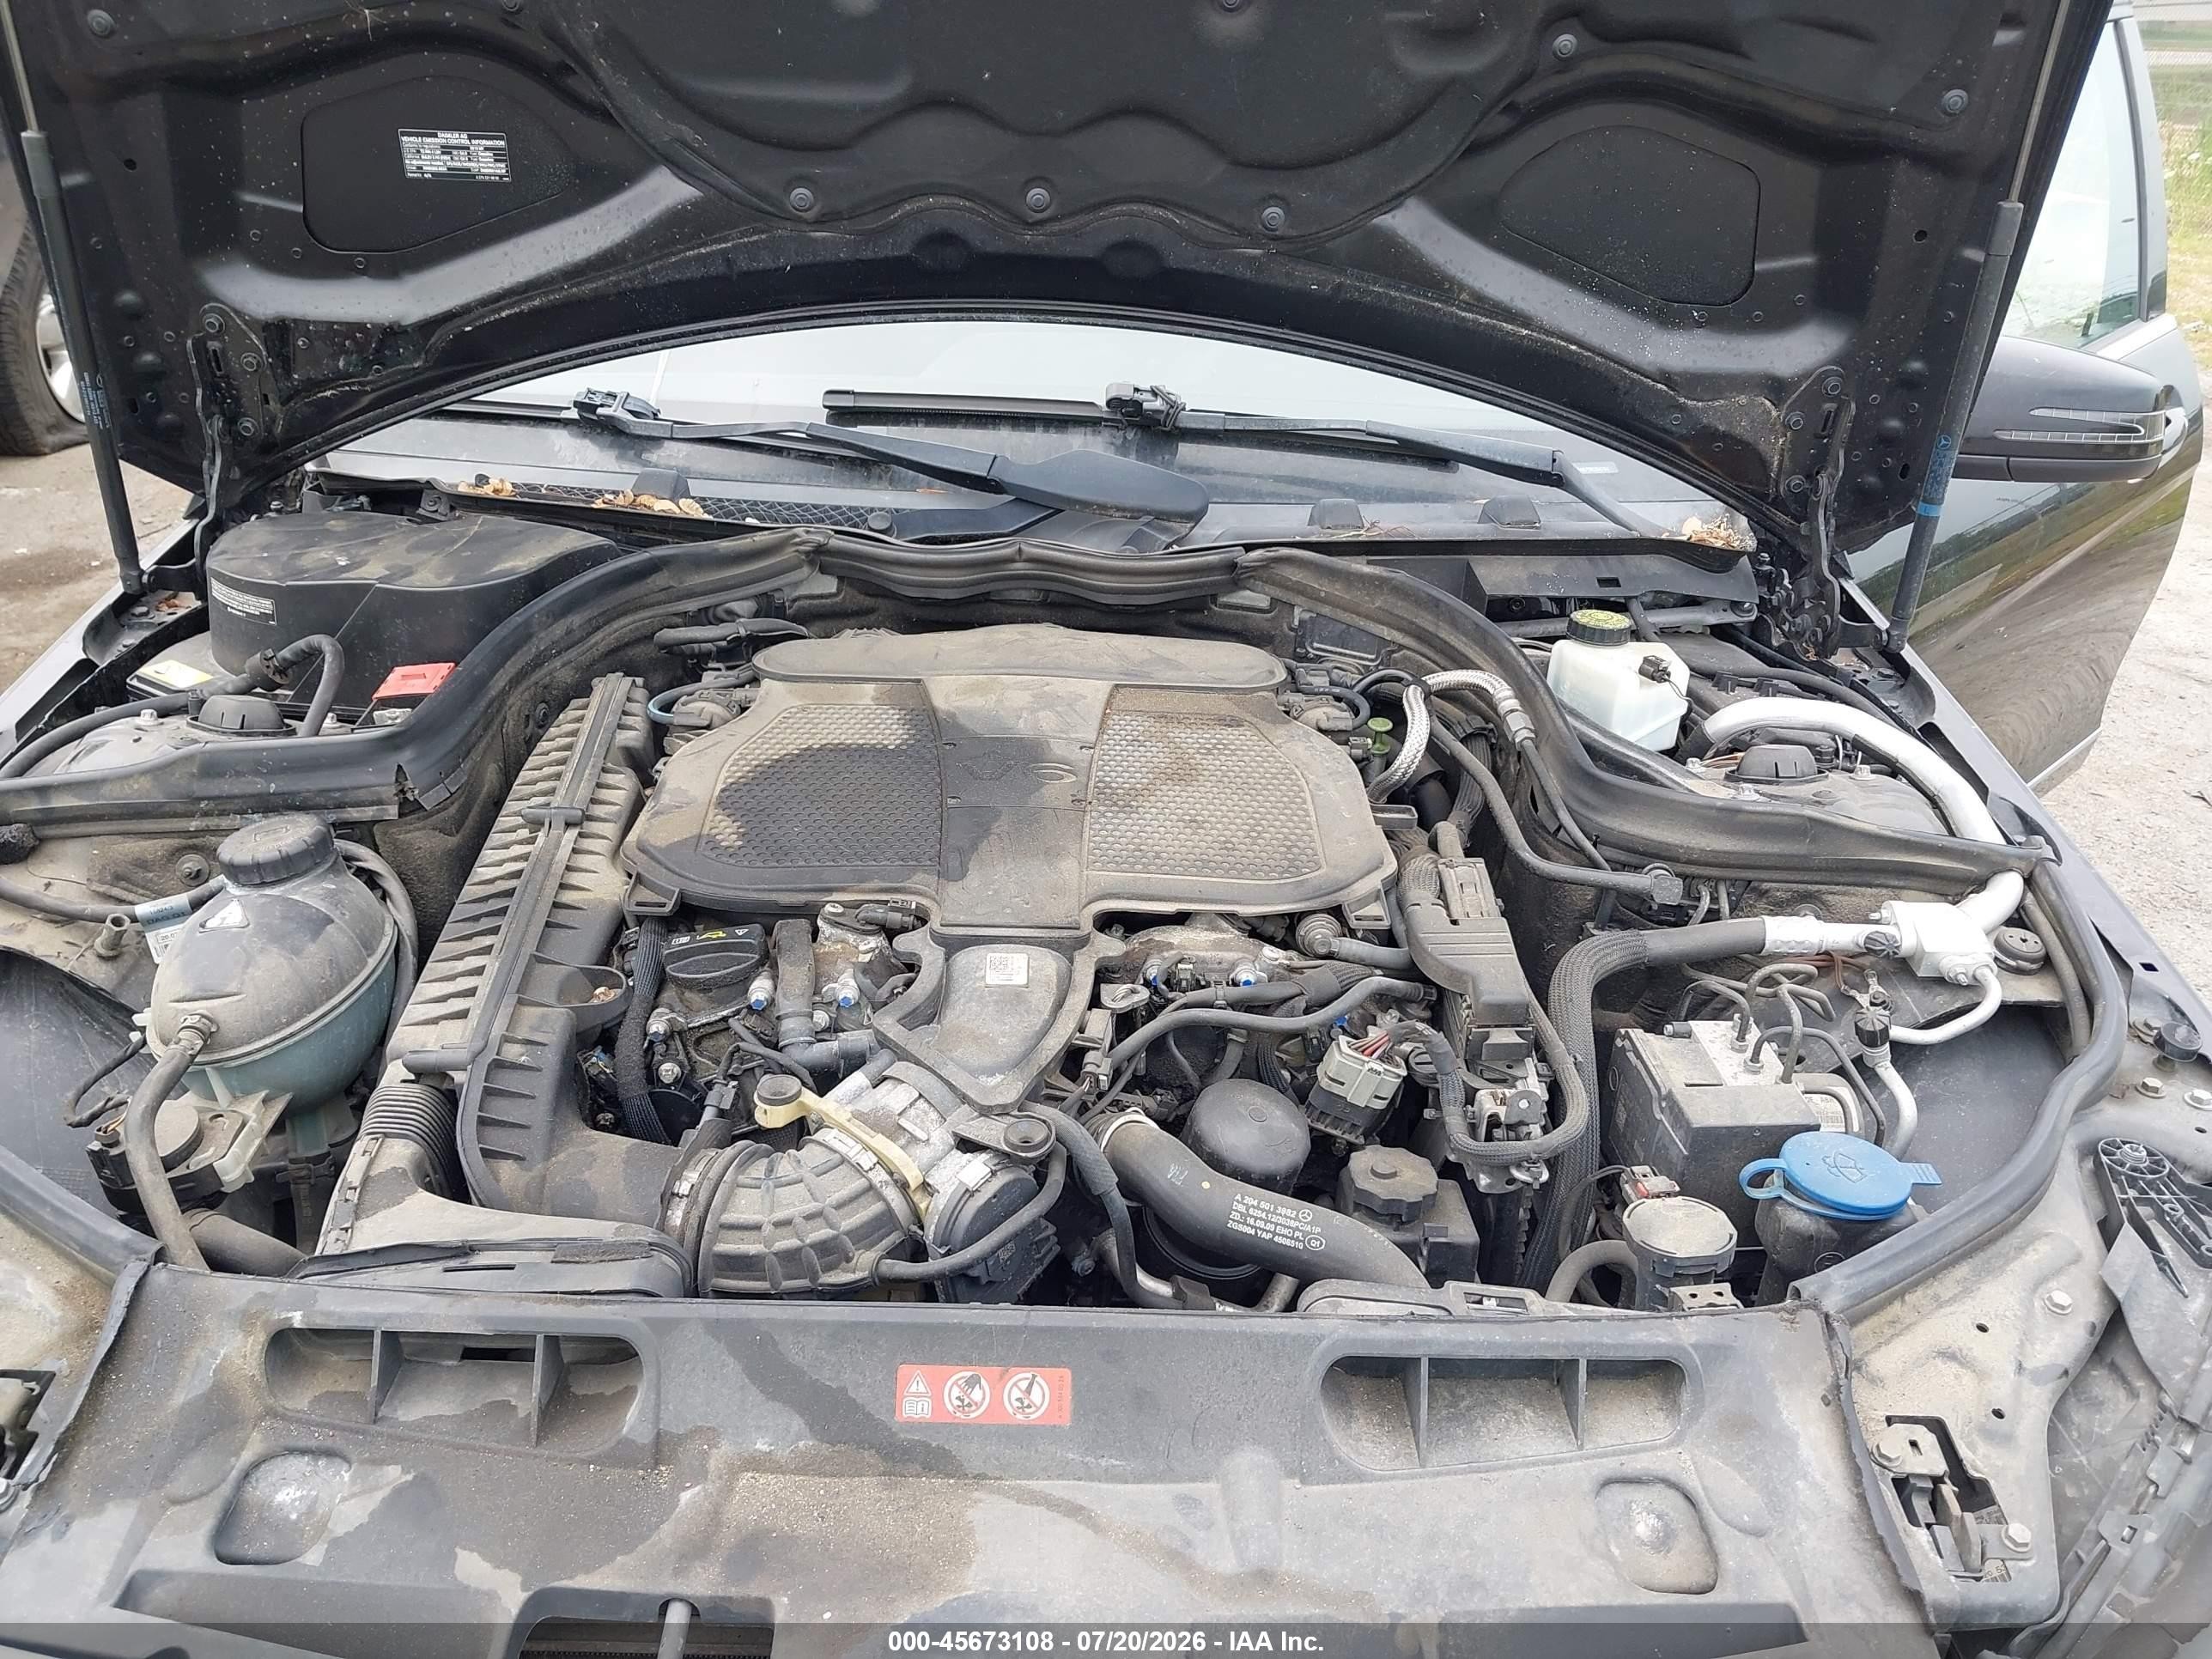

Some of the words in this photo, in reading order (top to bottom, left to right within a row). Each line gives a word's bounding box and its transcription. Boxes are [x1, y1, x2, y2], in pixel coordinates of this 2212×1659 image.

[1243, 1195, 1258, 1206] 204
[1232, 1201, 1247, 1213] DBL
[1256, 1229, 1273, 1240] YAP
[1275, 1225, 1293, 1237] EHO
[1294, 1231, 1304, 1240] PL
